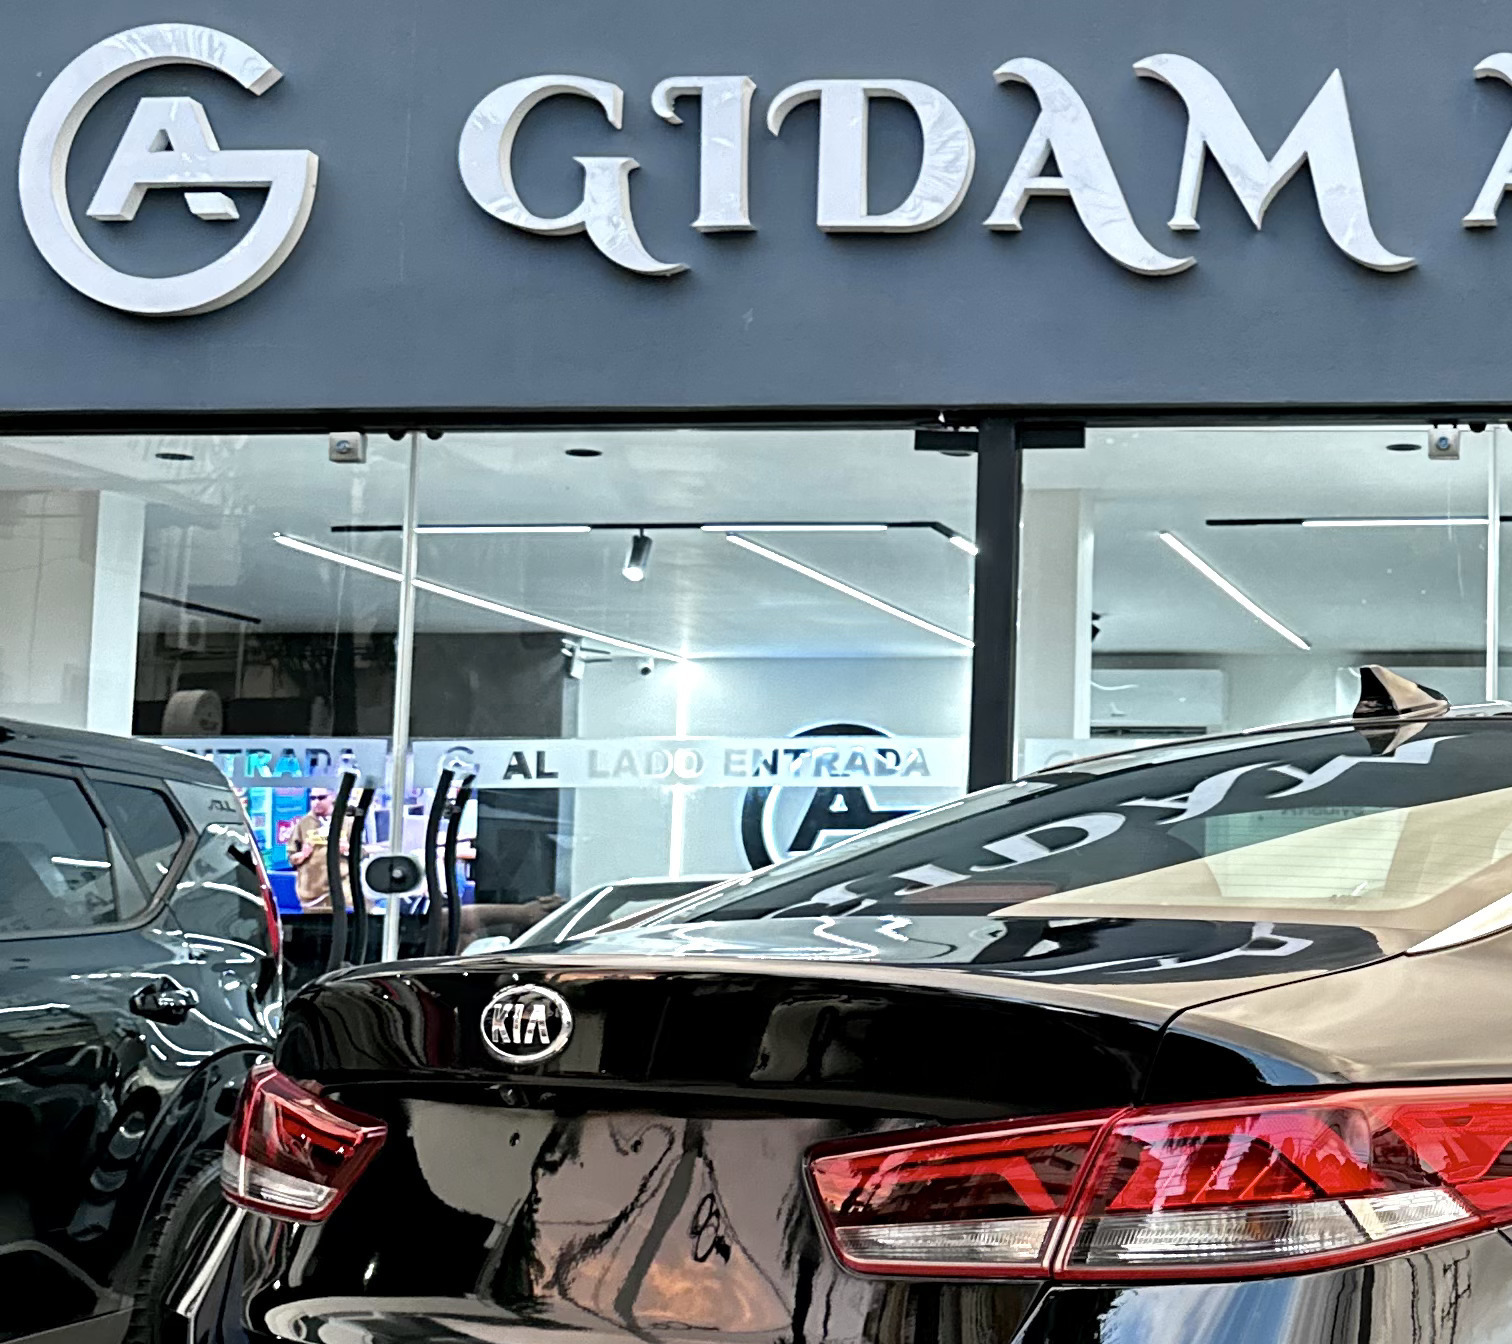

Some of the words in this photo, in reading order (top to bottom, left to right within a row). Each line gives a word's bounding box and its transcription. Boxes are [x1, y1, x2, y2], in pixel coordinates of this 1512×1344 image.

[458, 53, 1418, 277] GIDAM
[502, 750, 559, 780] AL
[587, 748, 704, 779] LADO
[723, 747, 932, 777] ENTRADA
[490, 1003, 551, 1045] KIA
